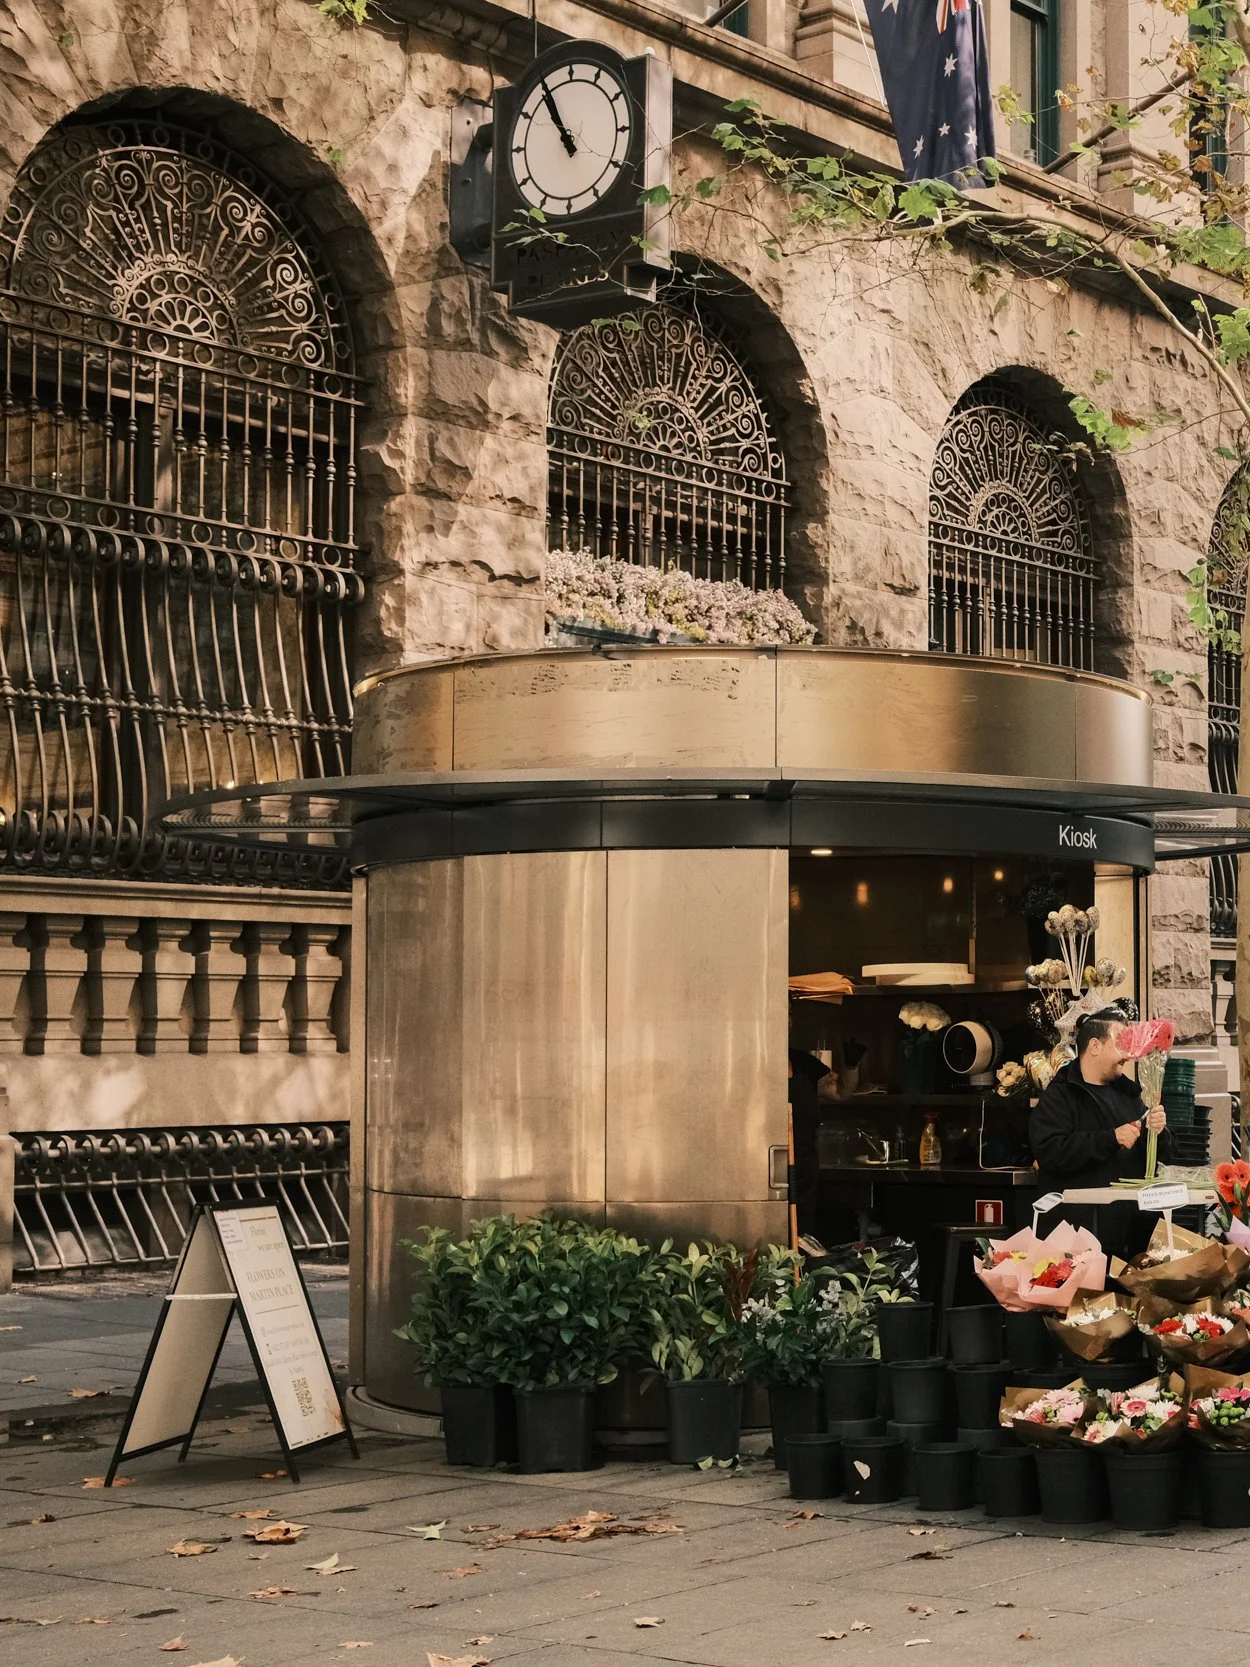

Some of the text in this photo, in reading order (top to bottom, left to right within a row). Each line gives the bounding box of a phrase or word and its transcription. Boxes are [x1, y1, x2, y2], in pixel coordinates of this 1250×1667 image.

[1059, 824, 1097, 849] Kiosk
[246, 1269, 276, 1284] FLOWERS
[249, 1284, 295, 1303] MARTIN PLACE
